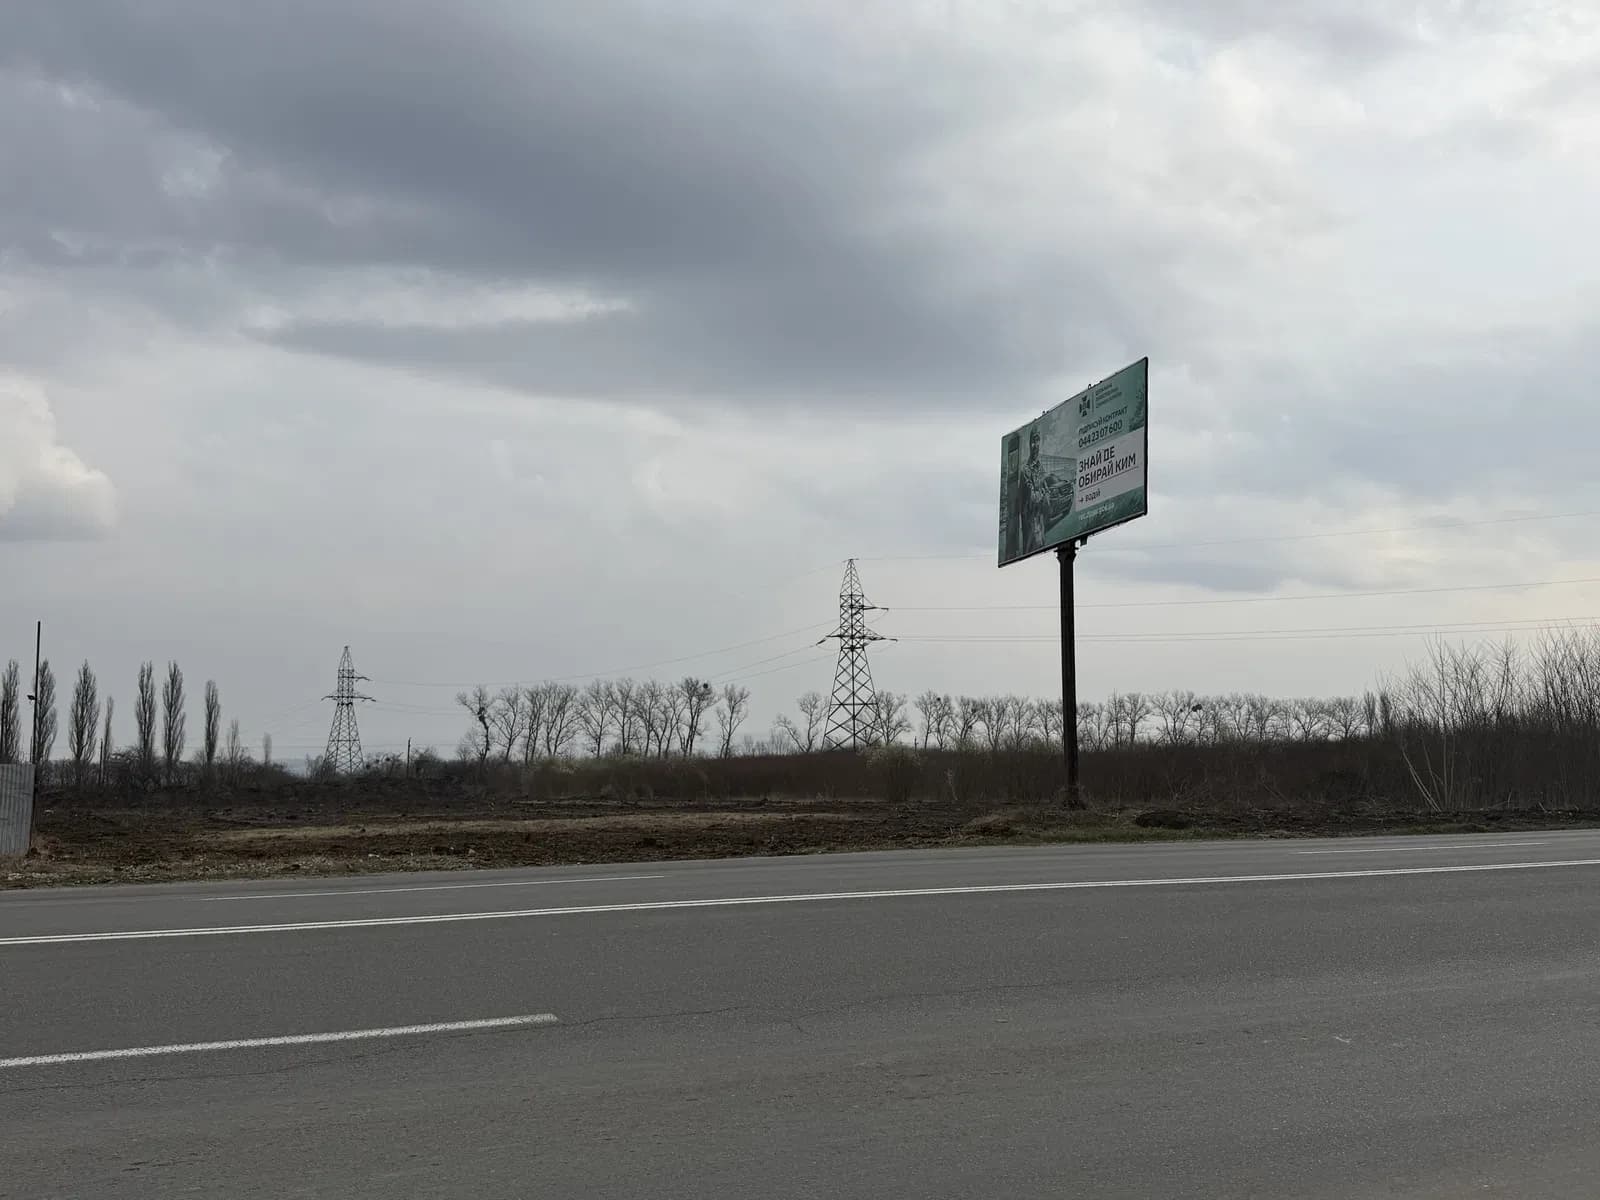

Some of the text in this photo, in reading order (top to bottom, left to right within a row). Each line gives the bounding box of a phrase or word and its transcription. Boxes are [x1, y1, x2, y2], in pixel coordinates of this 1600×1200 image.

[1079, 446, 1115, 473] ЗНАЙ ДЕ
[1079, 453, 1136, 488] ОБИРАЙ КИМ
